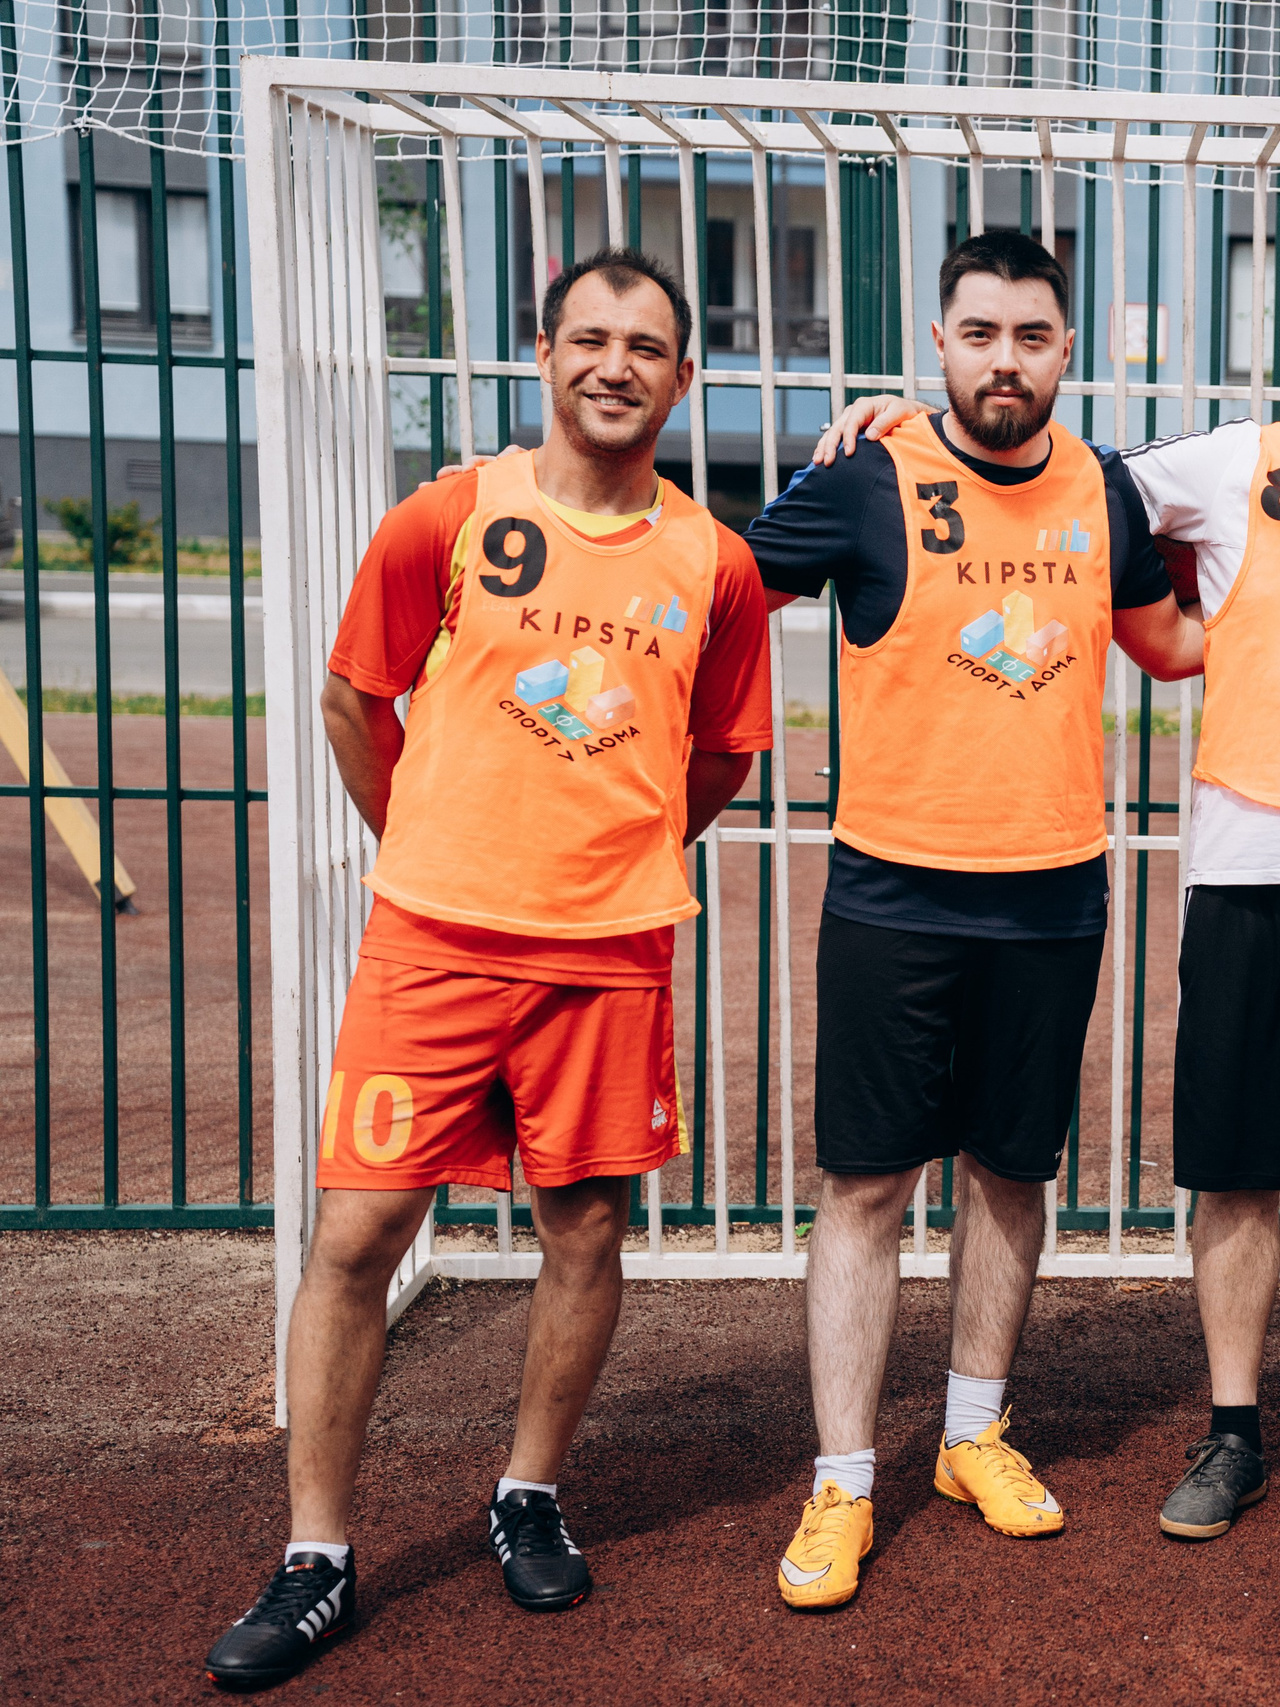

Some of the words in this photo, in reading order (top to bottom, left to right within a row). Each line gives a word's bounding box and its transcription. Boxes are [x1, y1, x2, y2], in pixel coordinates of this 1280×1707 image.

[915, 480, 966, 555] 3
[478, 516, 548, 598] 9
[957, 561, 1078, 585] KIPSTA
[519, 607, 662, 660] KIPSTA
[946, 653, 1012, 691] СПОРТ
[1009, 689, 1027, 700] У
[1030, 654, 1078, 693] ДОМА
[498, 699, 562, 747] СПОРТ
[556, 749, 575, 763] У
[583, 724, 642, 757] ДОМА
[322, 1070, 415, 1163] 10
